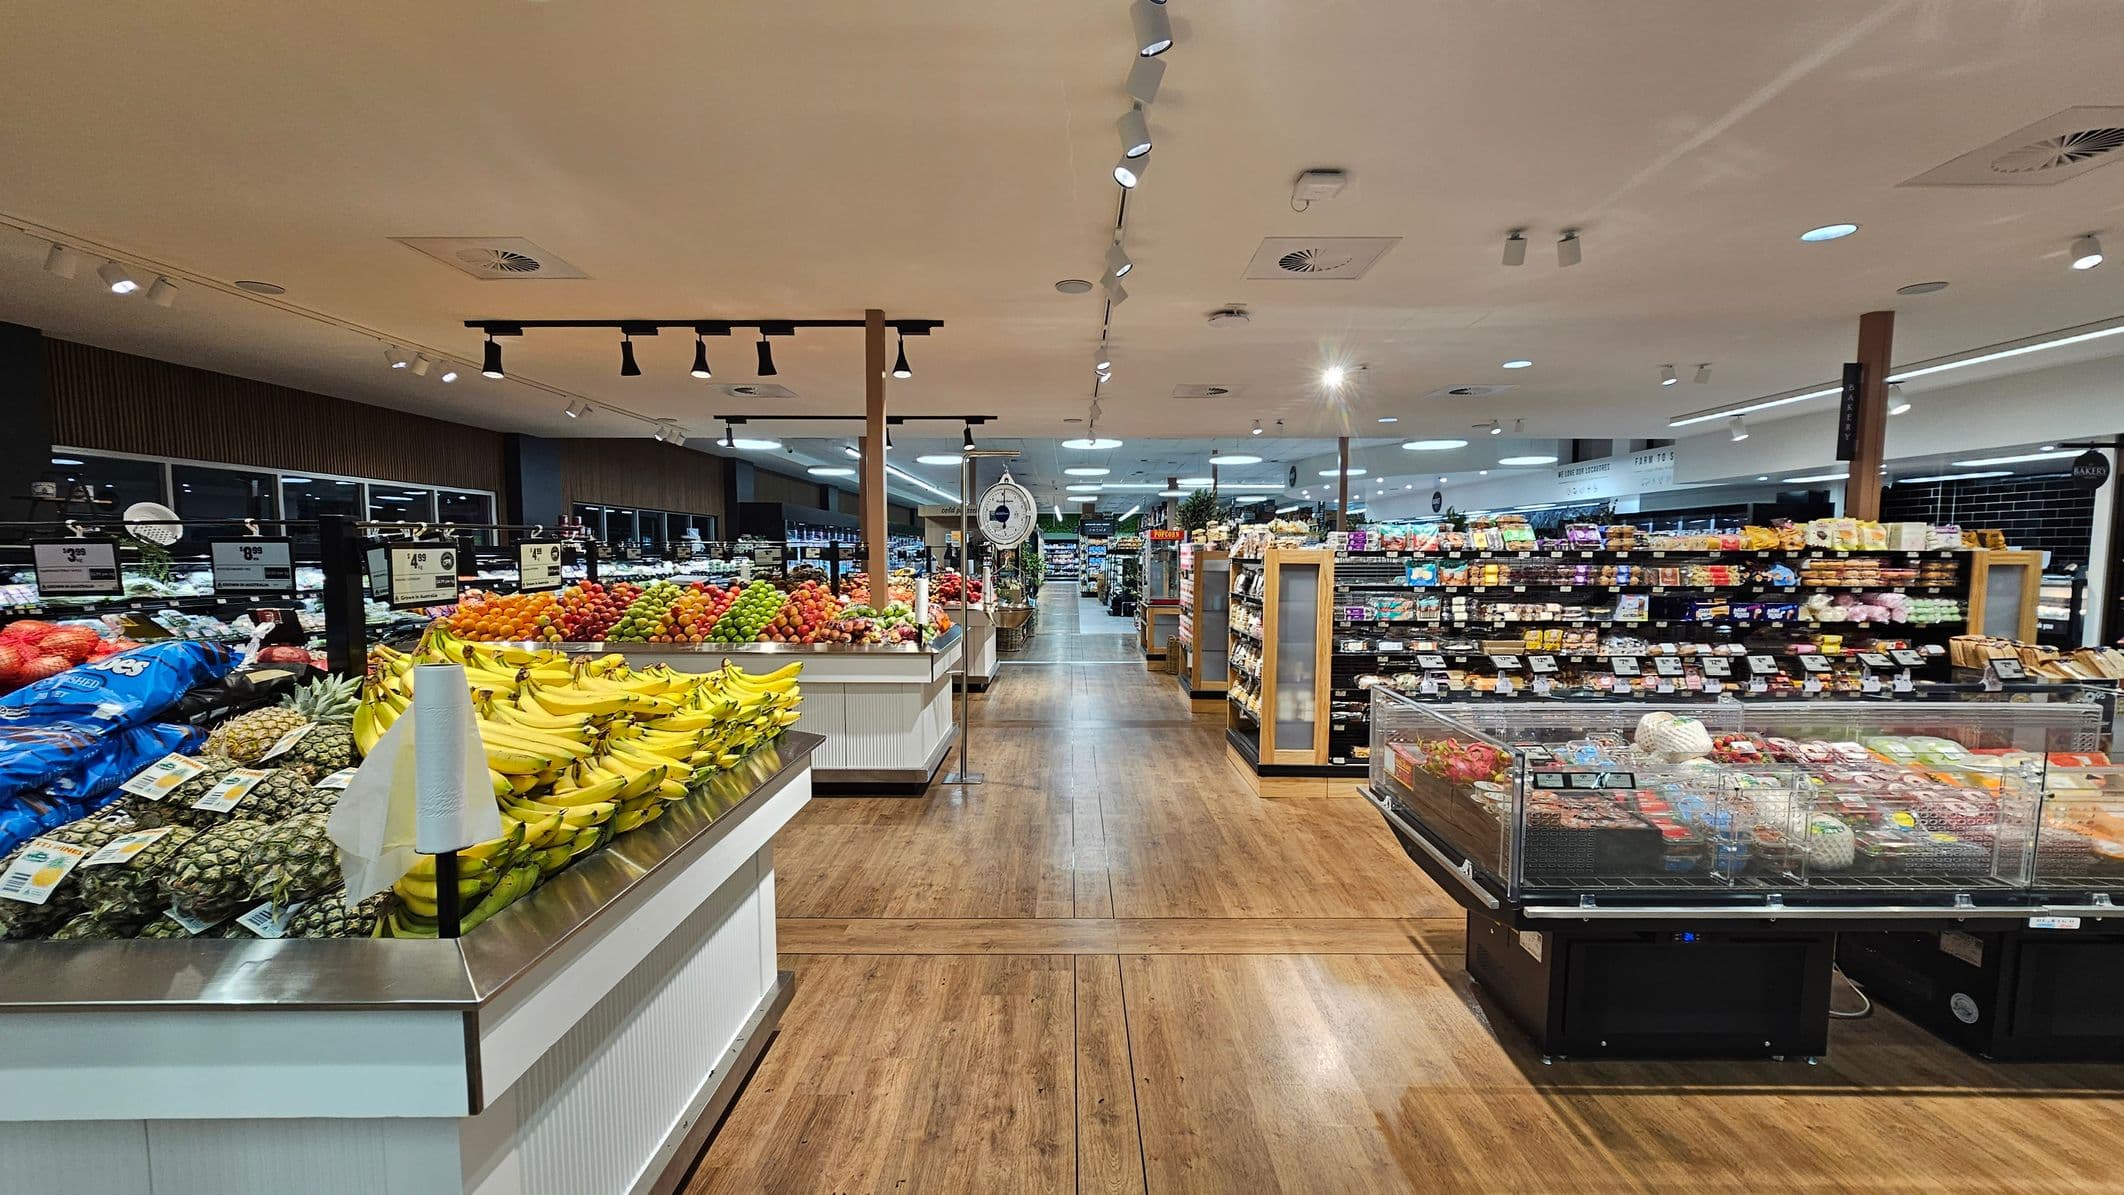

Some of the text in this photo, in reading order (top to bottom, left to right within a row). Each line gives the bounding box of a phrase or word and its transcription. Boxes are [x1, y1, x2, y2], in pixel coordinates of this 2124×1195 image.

[1844, 384, 1856, 441] BAKERY
[1634, 455, 1654, 466] FARM
[1657, 452, 1666, 463] TO
[2073, 466, 2106, 477] BAKERY
[1153, 530, 1180, 539] POPCORN
